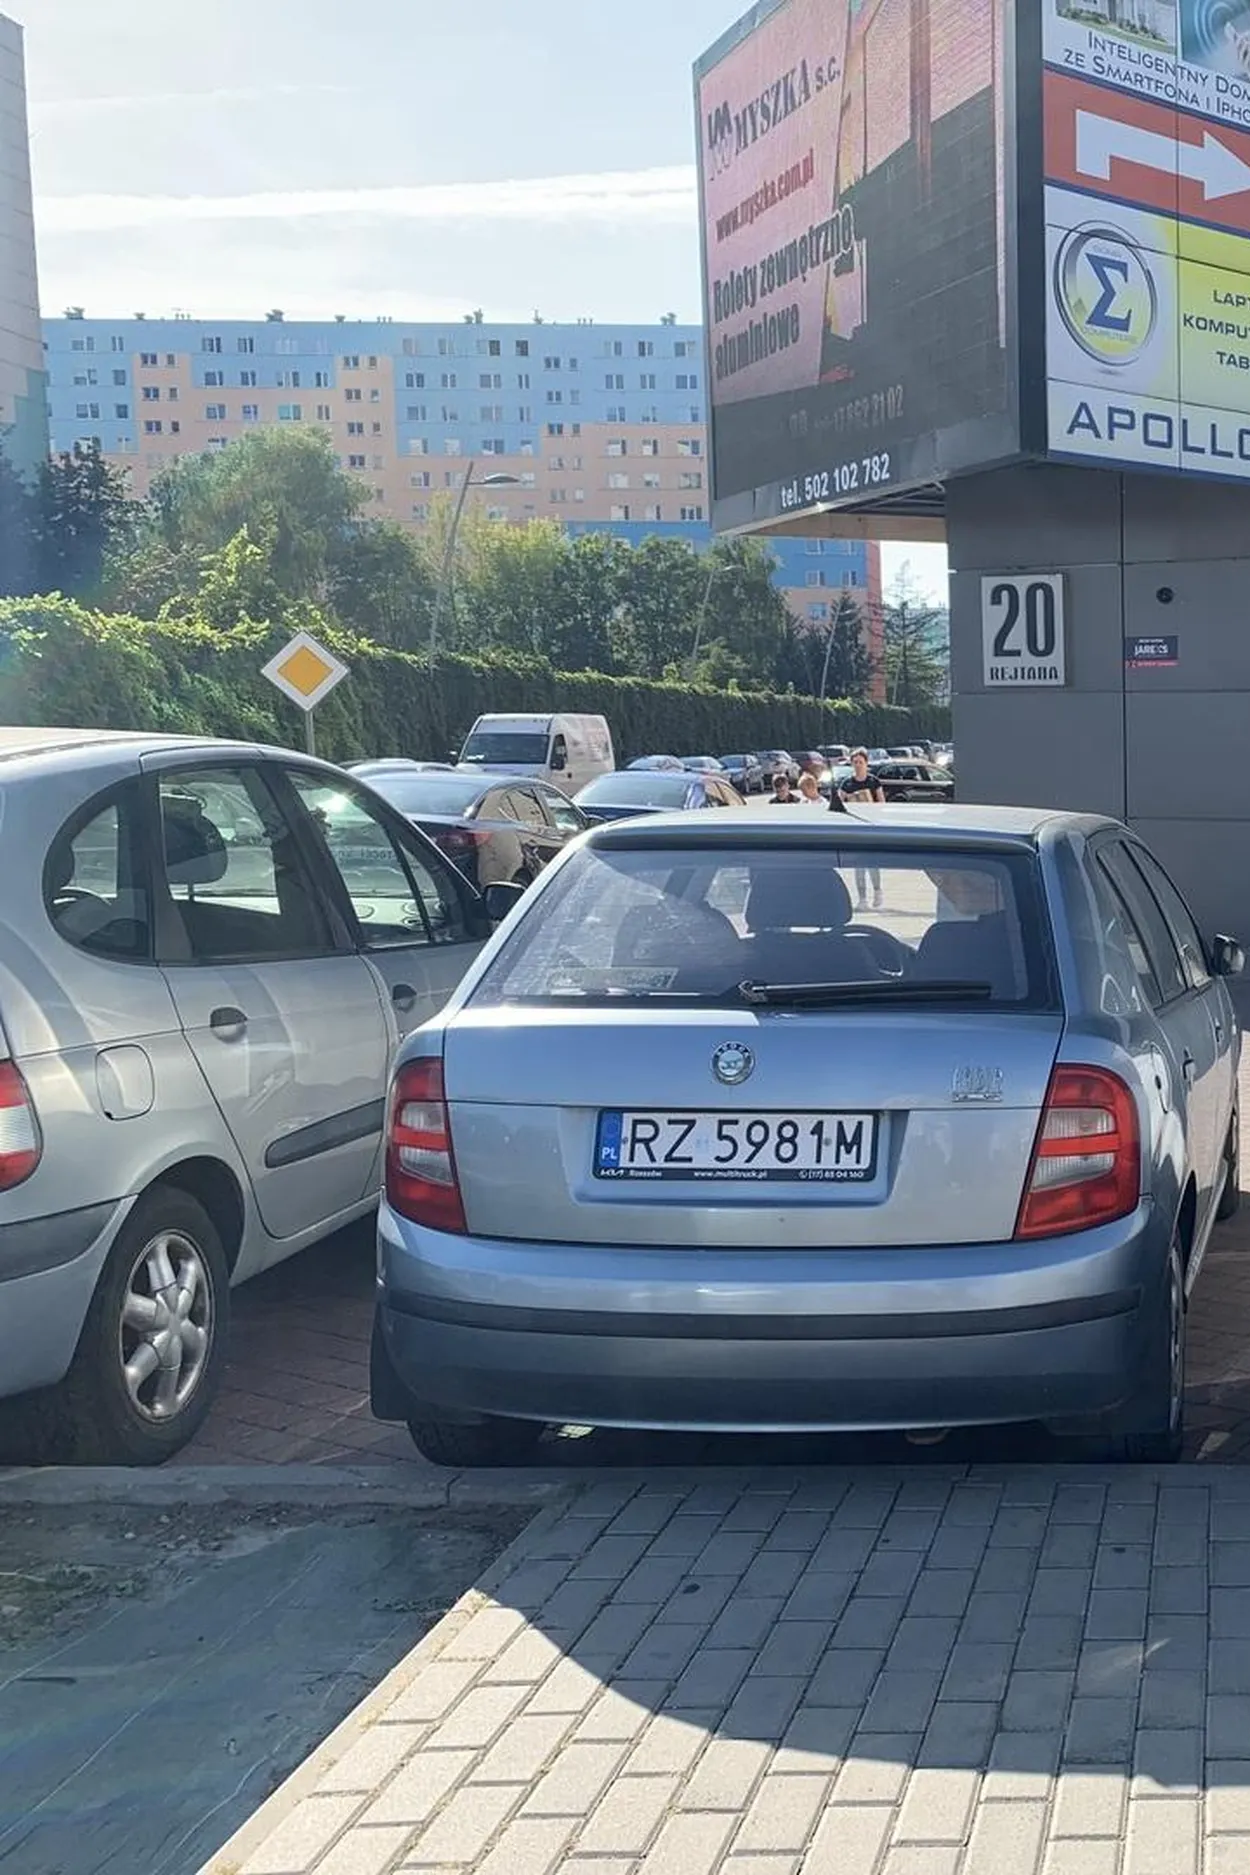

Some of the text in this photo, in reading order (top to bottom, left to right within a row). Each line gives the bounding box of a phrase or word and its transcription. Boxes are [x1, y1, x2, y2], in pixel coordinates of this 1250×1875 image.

[734, 58, 811, 156] MYSZKA
[713, 265, 757, 324] Rolety
[715, 303, 799, 381] aluminiowe
[781, 452, 890, 508] tel. 502 102 782
[990, 582, 1056, 657] 20
[990, 666, 1058, 681] REJTANA
[601, 1147, 617, 1160] PL
[629, 1119, 864, 1164] RZ 5981M
